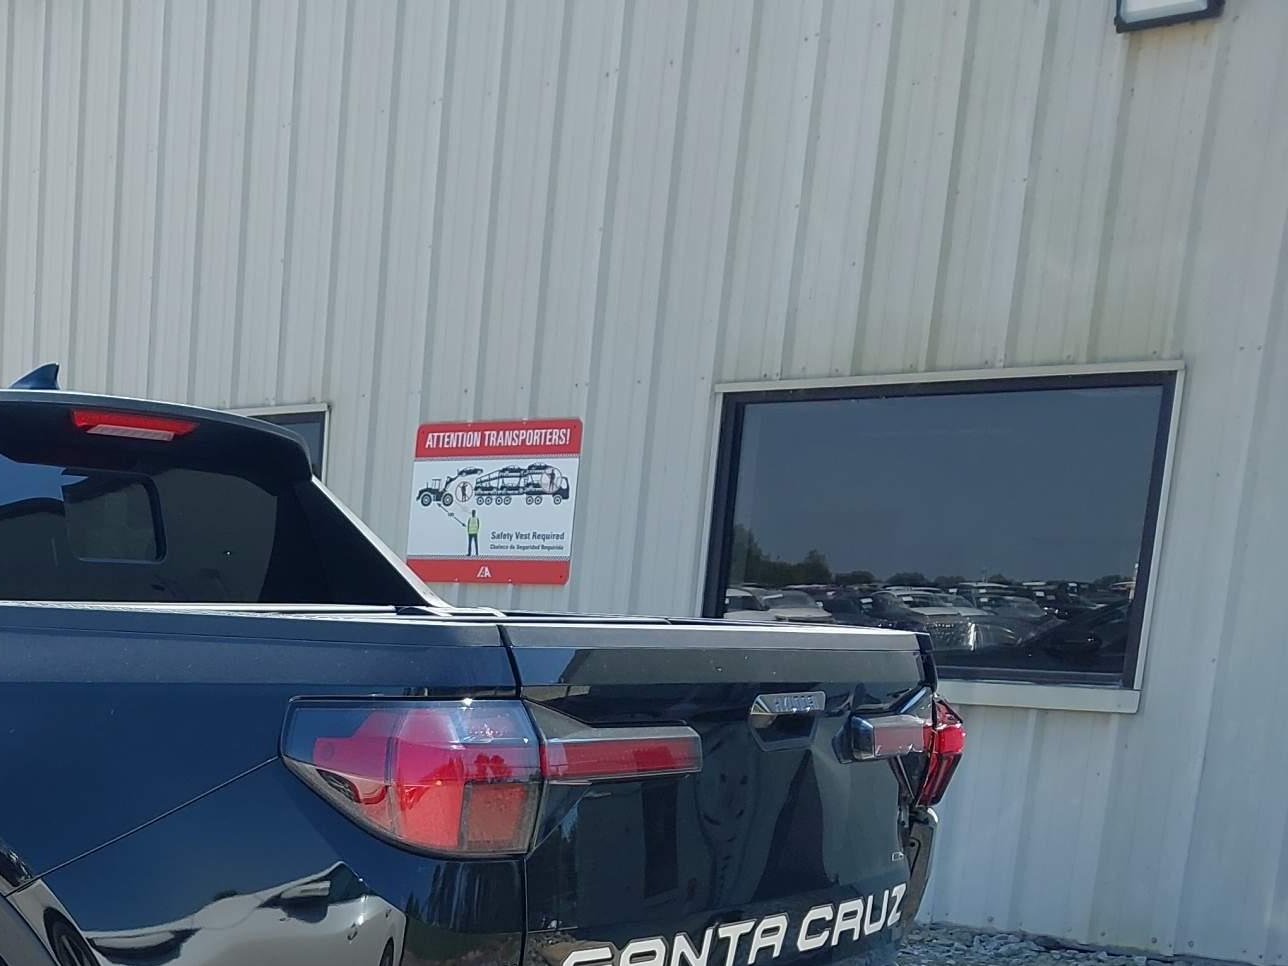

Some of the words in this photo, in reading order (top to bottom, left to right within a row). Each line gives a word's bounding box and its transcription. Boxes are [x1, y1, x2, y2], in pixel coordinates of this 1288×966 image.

[425, 431, 481, 449] ATTENTION
[484, 428, 571, 447] TRANSPORTERS!
[490, 531, 513, 541] Safety
[515, 531, 530, 540] Vest
[532, 531, 565, 542] Required
[797, 883, 907, 952] CRUZ
